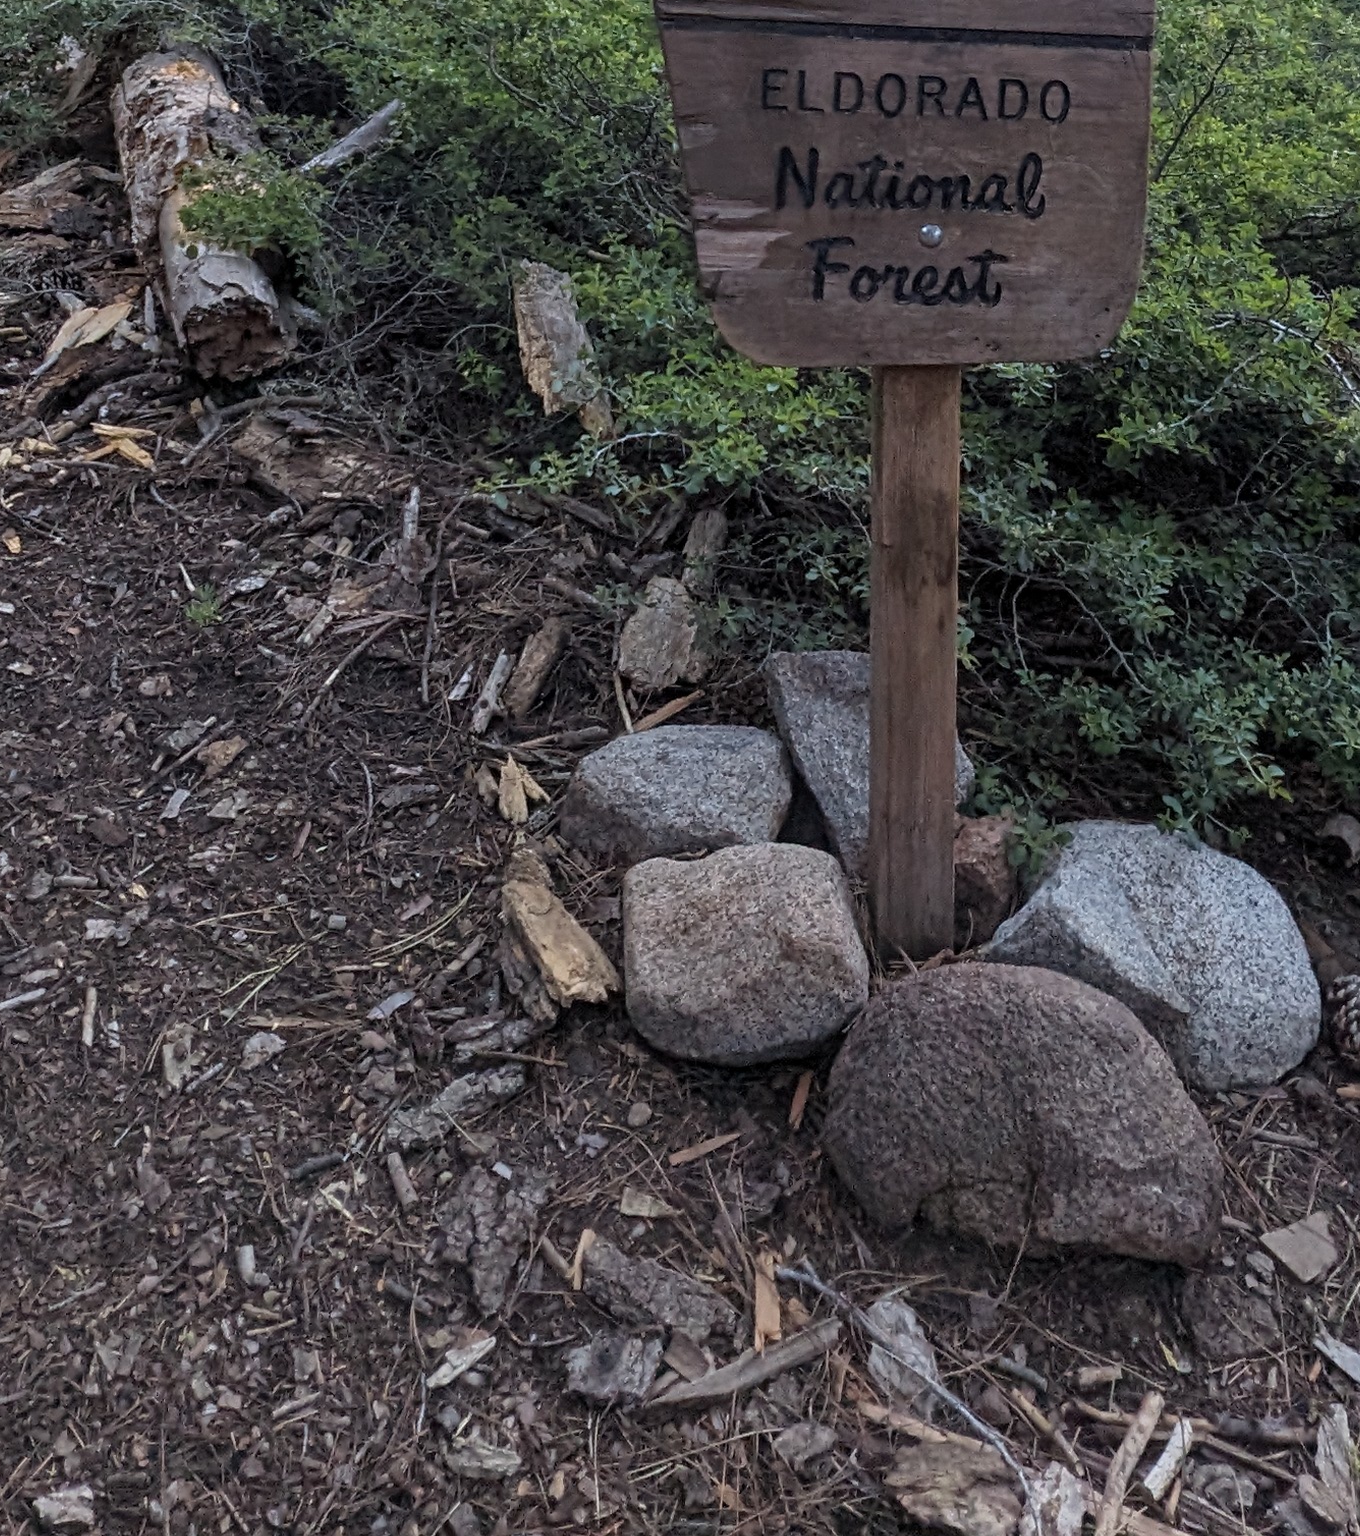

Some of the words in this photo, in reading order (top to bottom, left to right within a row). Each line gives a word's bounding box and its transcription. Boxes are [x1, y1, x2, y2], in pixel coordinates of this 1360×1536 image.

[761, 68, 1071, 123] ELDORADO
[776, 146, 1046, 219] National
[806, 235, 1009, 307] Forest
